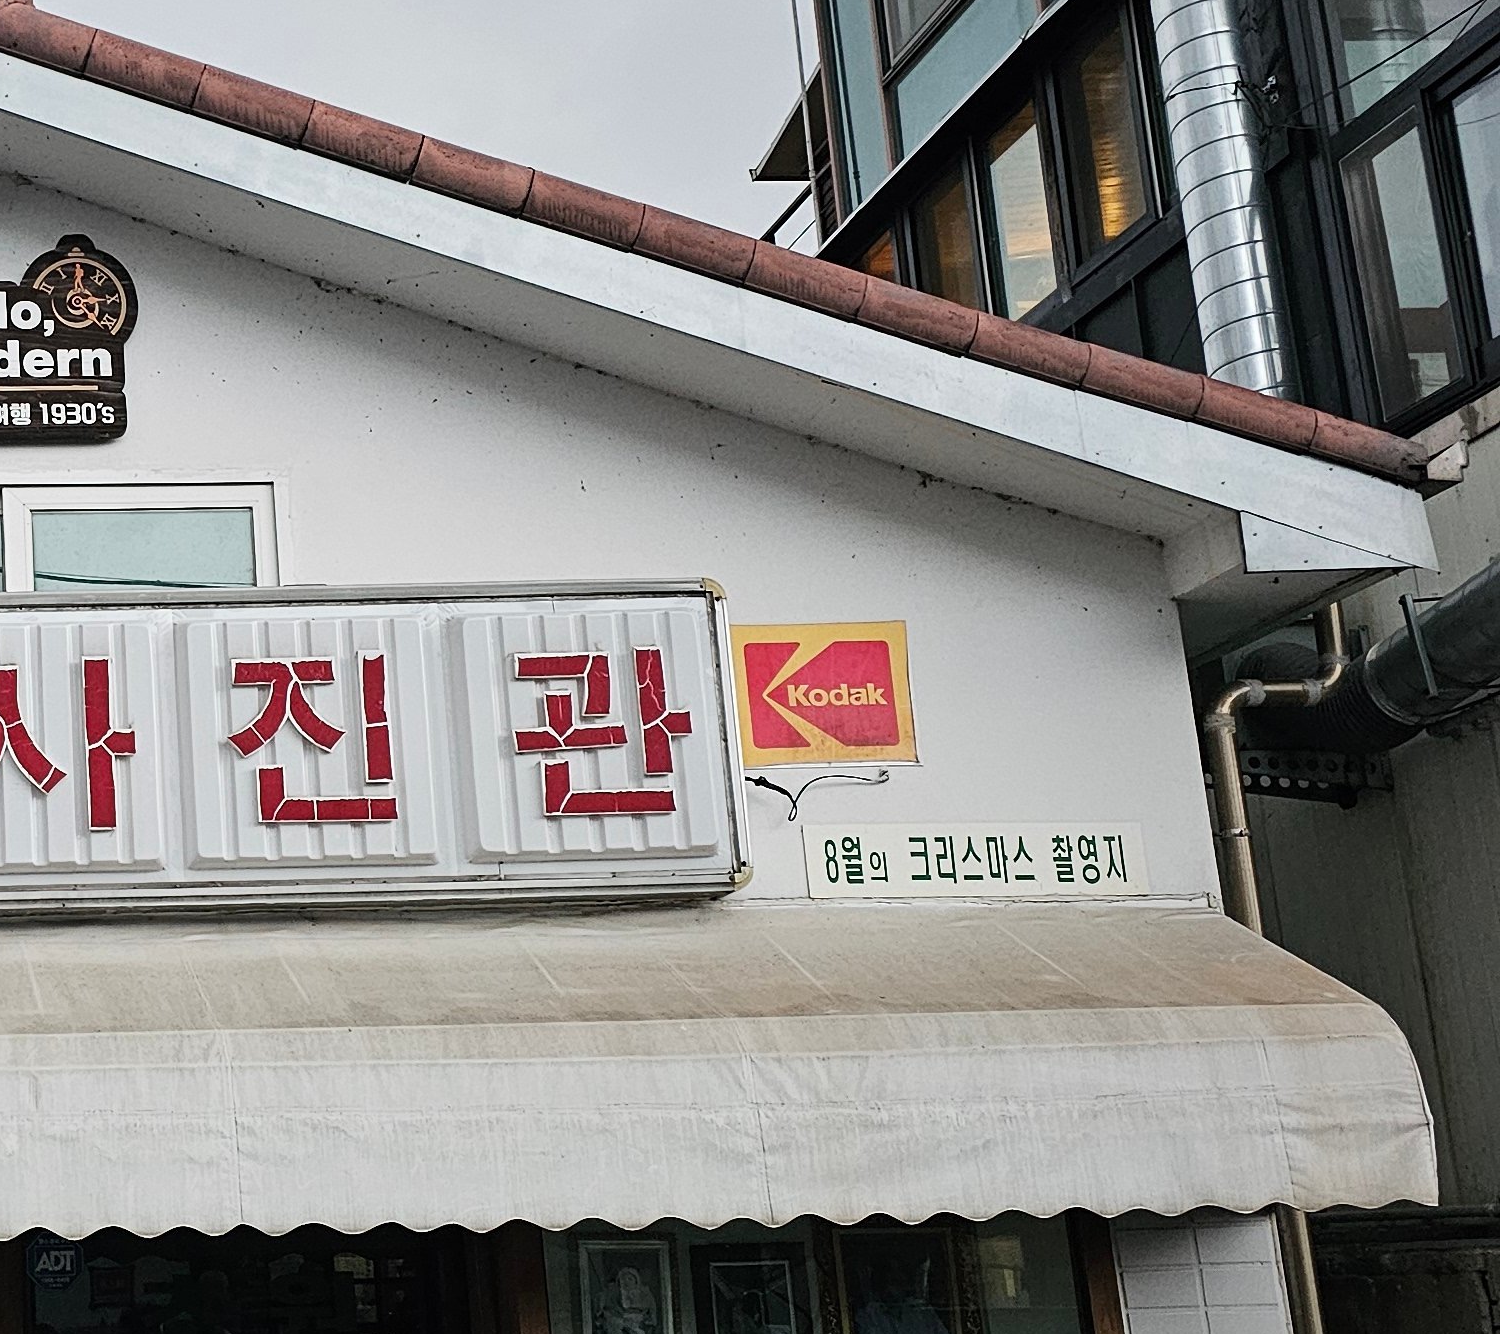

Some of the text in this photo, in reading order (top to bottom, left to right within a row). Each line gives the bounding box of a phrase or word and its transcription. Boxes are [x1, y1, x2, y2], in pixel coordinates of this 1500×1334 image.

[39, 402, 115, 425] 1930's
[787, 682, 889, 707] Kodak
[824, 834, 1129, 885] 8월의 크리스마스 촬영지
[35, 1250, 75, 1272] ADT
